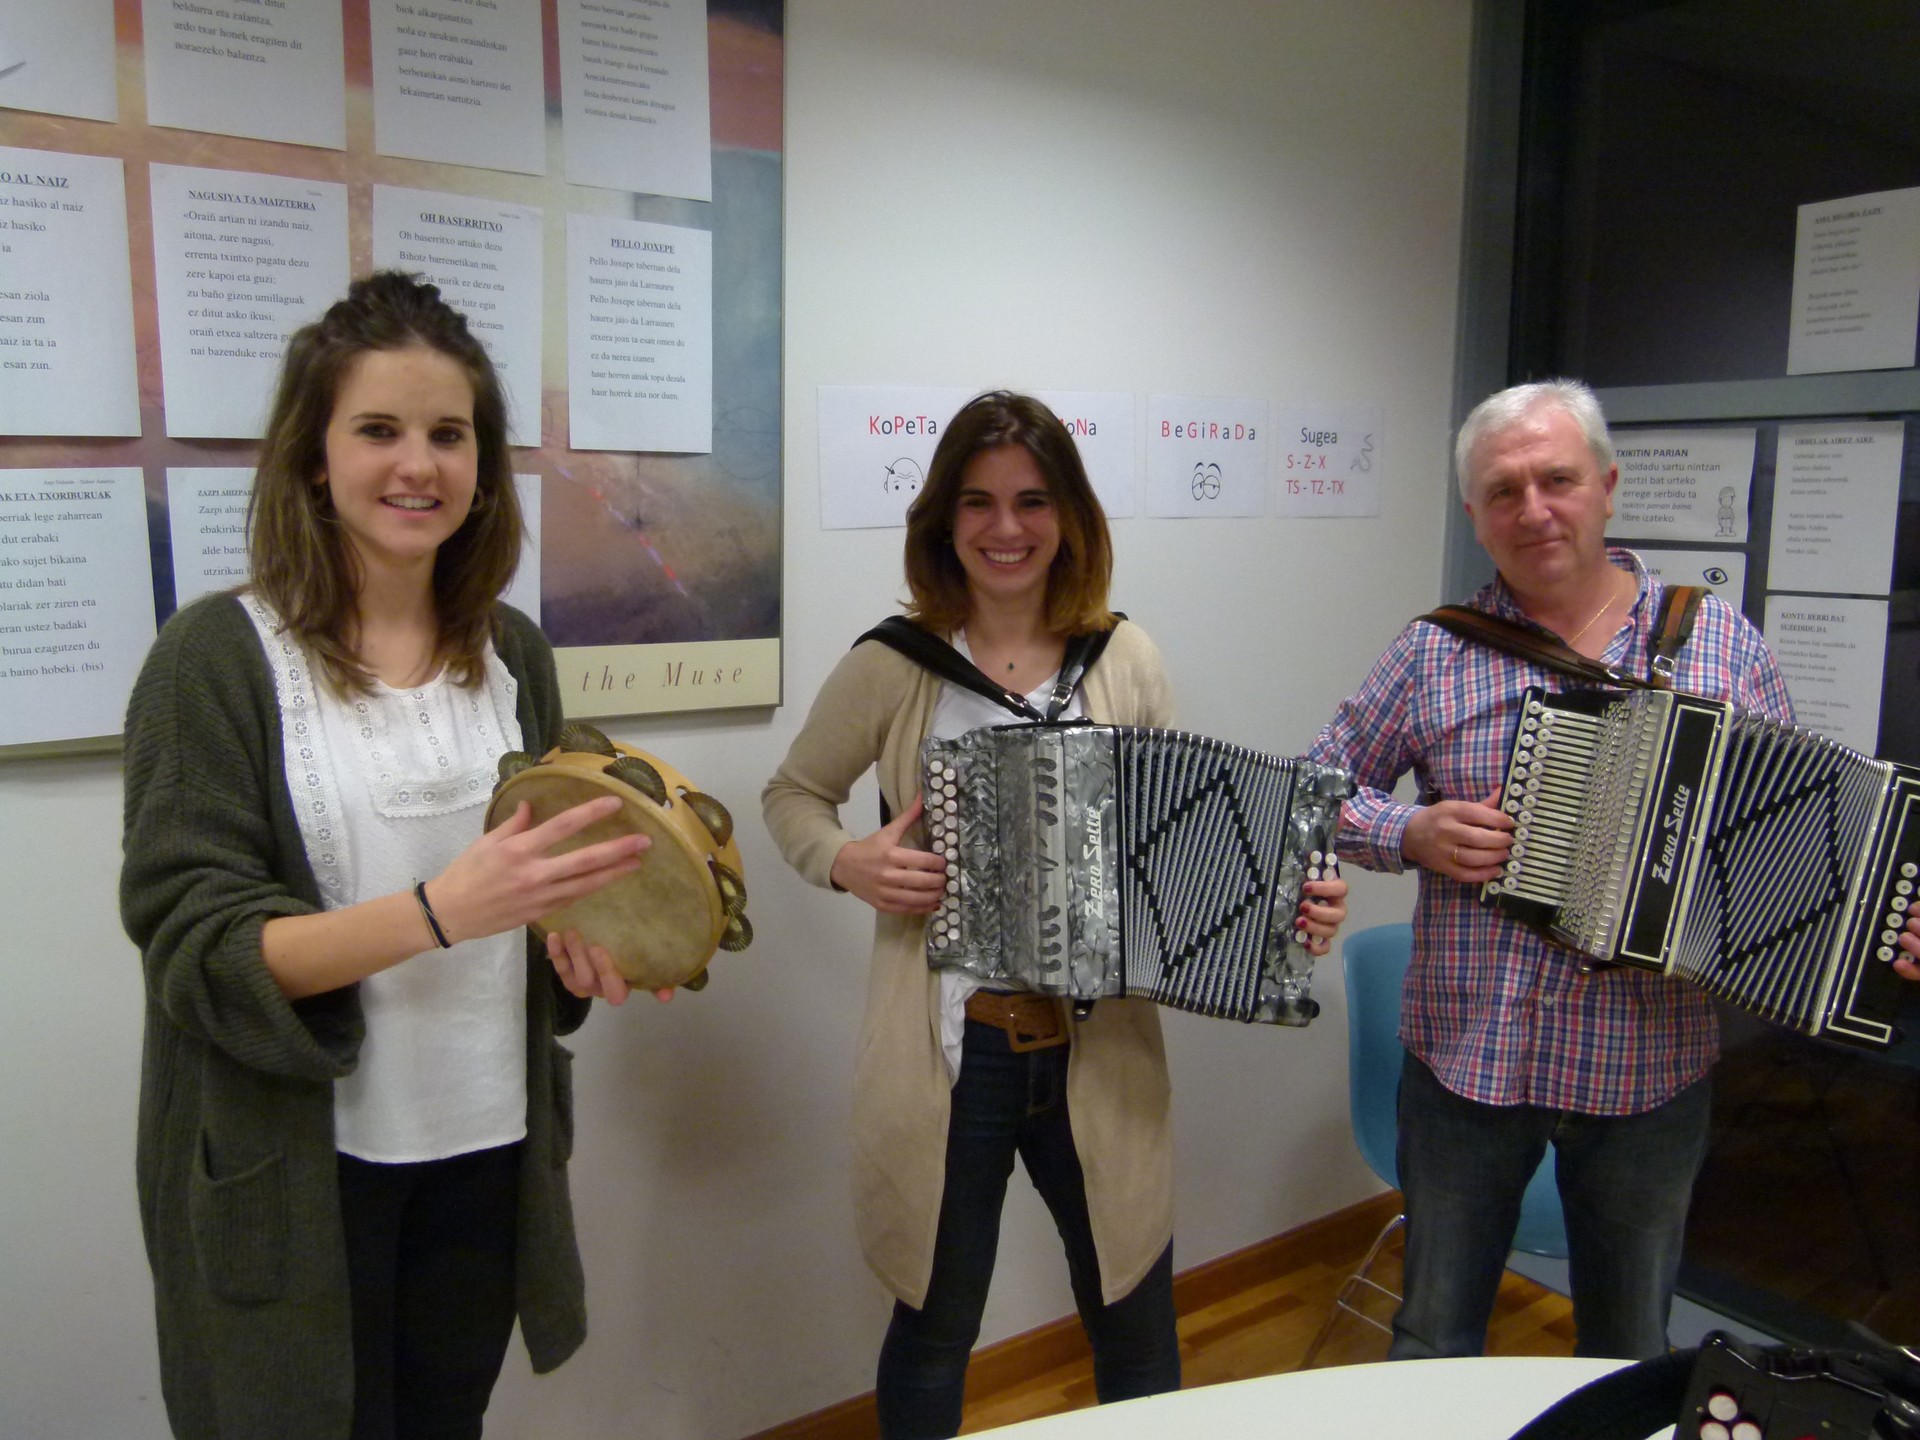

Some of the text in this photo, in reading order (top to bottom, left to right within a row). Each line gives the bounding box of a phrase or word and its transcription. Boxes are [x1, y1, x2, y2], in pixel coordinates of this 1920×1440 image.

[14, 174, 68, 188] AL NAIZ
[12, 196, 84, 212] hasiko al naiz
[188, 190, 316, 210] NAGUSIYA TA MAIZTERRA
[11, 219, 46, 231] hasiko
[218, 215, 245, 224] artian
[259, 219, 289, 228] izandu
[419, 212, 436, 222] OH
[438, 214, 502, 231] BASERRITXO
[183, 231, 216, 241] aitona,
[218, 234, 239, 242] zure
[398, 230, 502, 251] Oh baserritxo artuko dezu
[184, 251, 309, 267] errenta txintxo pagatu dezu
[399, 250, 426, 261] Bihotz
[428, 254, 478, 268] barrenetikan
[186, 270, 205, 278] zere
[208, 269, 234, 282] kapoi
[201, 288, 224, 298] baño
[226, 292, 252, 301] gizon
[254, 293, 304, 305] umillaguak
[0, 314, 23, 322] esan
[201, 308, 223, 317] ditut
[225, 310, 247, 319] asko
[189, 327, 278, 339] oraiñ etxea saltzera
[21, 336, 56, 347] ia ta ia
[3, 361, 27, 369] esan
[869, 416, 937, 435] KoPeTa
[1162, 421, 1256, 440] BeGiRaDa
[1301, 427, 1337, 447] Sugea
[1615, 449, 1688, 457] TXIKITIN PARIAN
[1624, 462, 1720, 471] Soldadu sartu nintzan
[1623, 476, 1696, 484] zortzi bat urteko
[14, 491, 111, 501] ETA TXORIBURUAK
[1622, 489, 1696, 499] errege serbidu ta
[198, 505, 222, 515] Zazpi
[34, 511, 102, 523] lege zaharrean
[1621, 512, 1640, 521] libre
[1, 533, 59, 544] dut erabaki
[22, 555, 87, 567] sujet bikaina
[15, 577, 66, 588] didan bati
[54, 600, 79, 608] ziren
[24, 620, 86, 631] ustez badaki
[2, 640, 99, 655] burua ezagutzen du
[9, 668, 38, 676] baino
[81, 662, 104, 672] (bis)
[582, 661, 743, 692] the Muse
